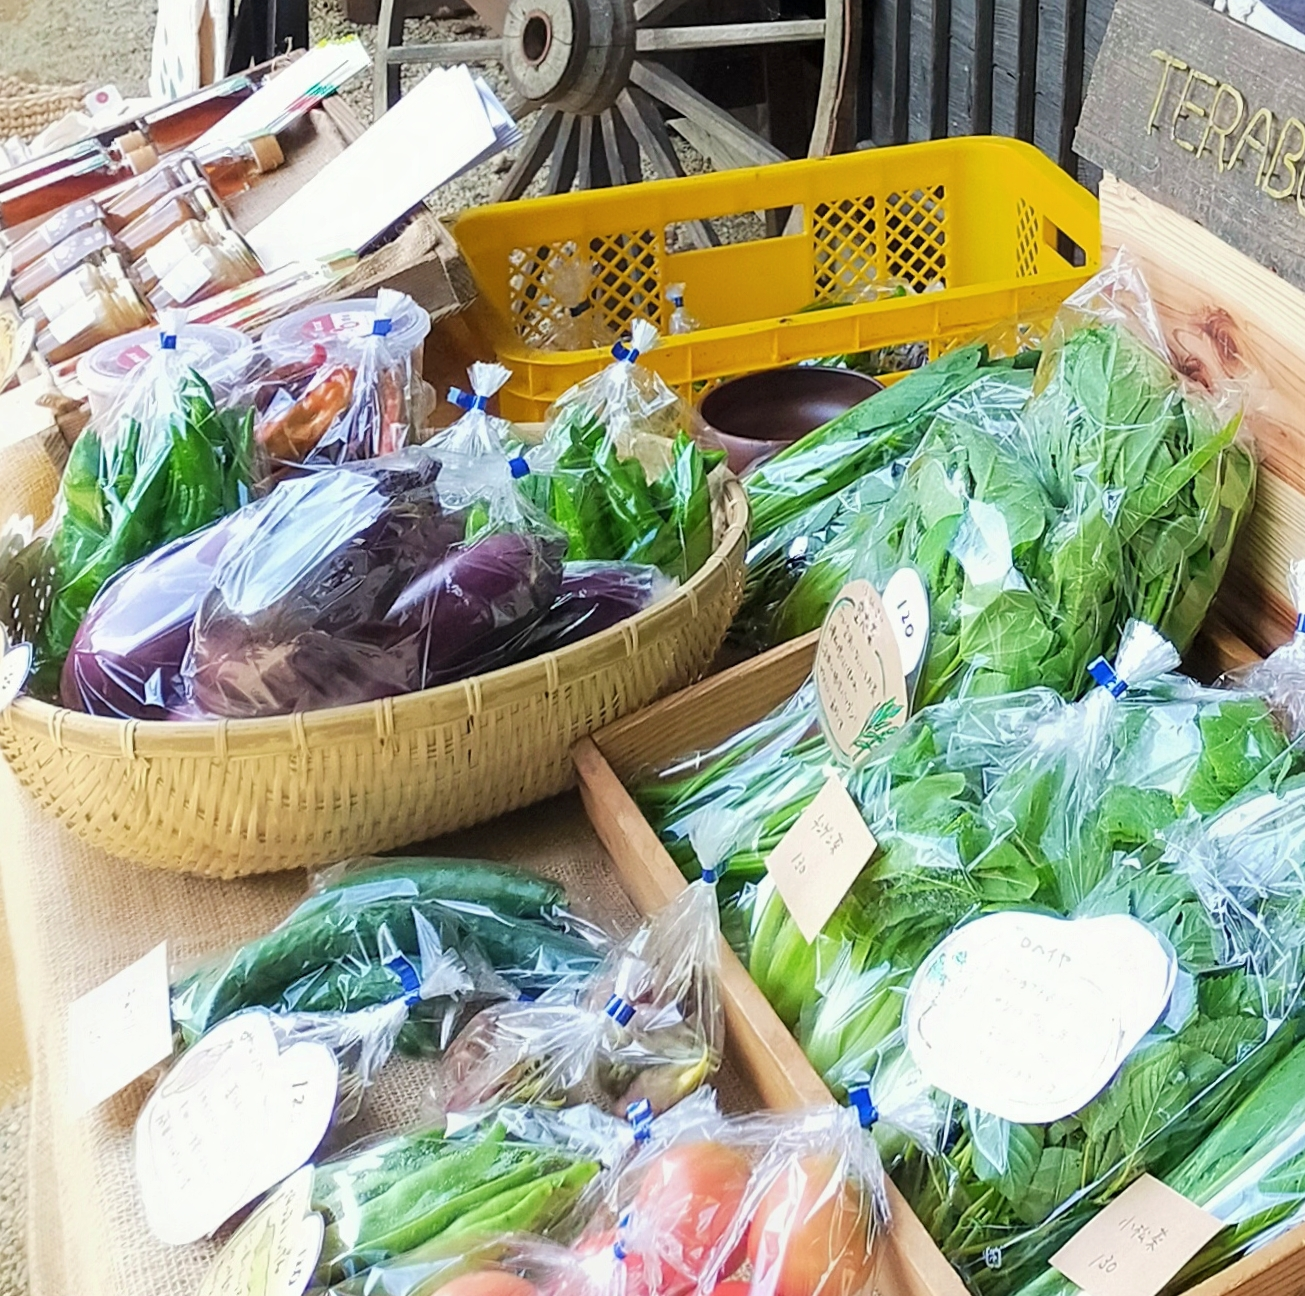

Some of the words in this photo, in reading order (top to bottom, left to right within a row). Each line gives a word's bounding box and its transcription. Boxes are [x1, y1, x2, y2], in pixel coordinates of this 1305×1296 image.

[896, 598, 915, 638] 120
[789, 850, 807, 874] 130
[1013, 925, 1073, 969] ロヘイヤ
[1118, 1215, 1170, 1253] 小松菜
[1087, 1253, 1118, 1275] 130
